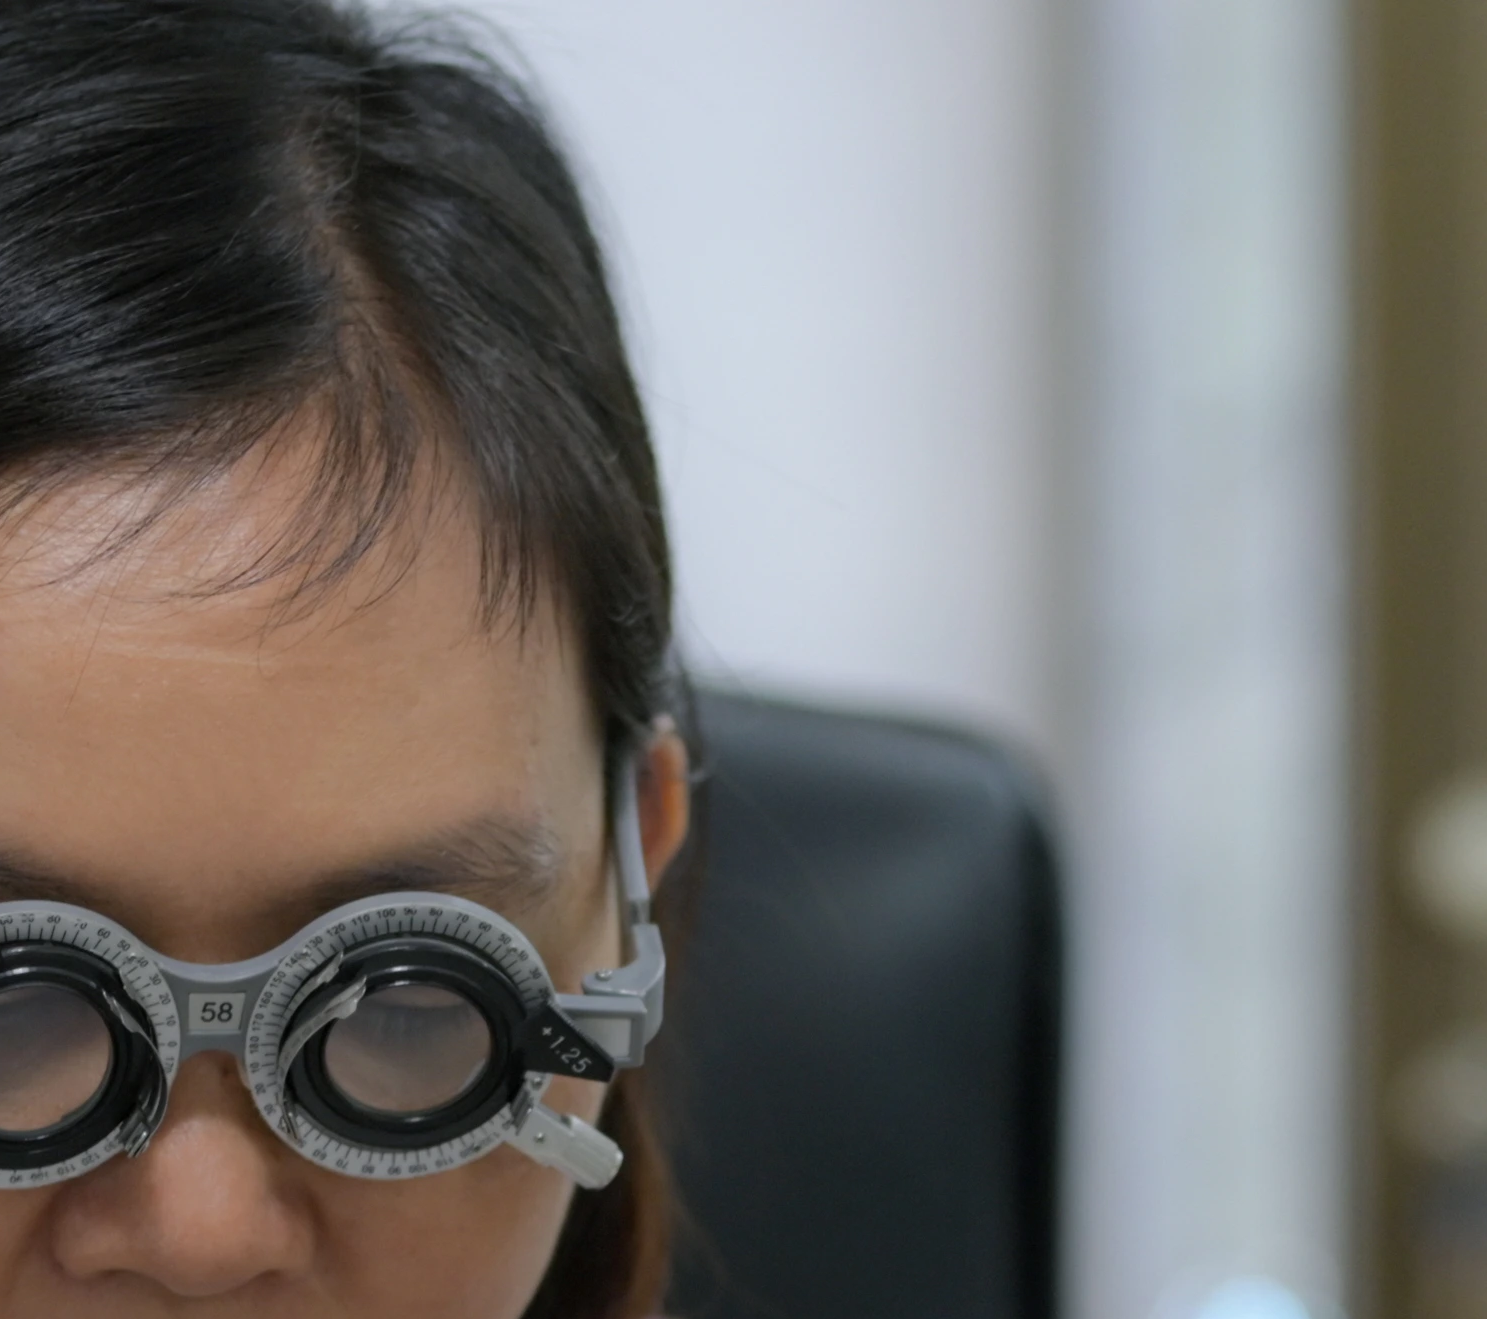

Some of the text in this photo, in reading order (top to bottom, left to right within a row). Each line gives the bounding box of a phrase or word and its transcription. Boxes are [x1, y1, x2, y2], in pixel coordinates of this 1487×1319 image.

[97, 928, 111, 940] 60
[117, 939, 131, 951] 50
[149, 973, 162, 986] 30
[159, 993, 171, 1006] 20
[166, 1014, 176, 1027] 10
[252, 1013, 264, 1031] 170
[259, 992, 274, 1010] 160
[269, 970, 286, 989] 150
[304, 935, 323, 950] 130
[326, 922, 346, 936] 120
[351, 914, 371, 926] 110
[376, 908, 396, 919] 100
[429, 907, 443, 917] 80
[456, 912, 470, 924] 70
[478, 921, 492, 932] 60
[498, 933, 512, 945] 50
[200, 1001, 234, 1023] 58
[542, 1026, 592, 1073] +1.25
[336, 1158, 350, 1170] 70
